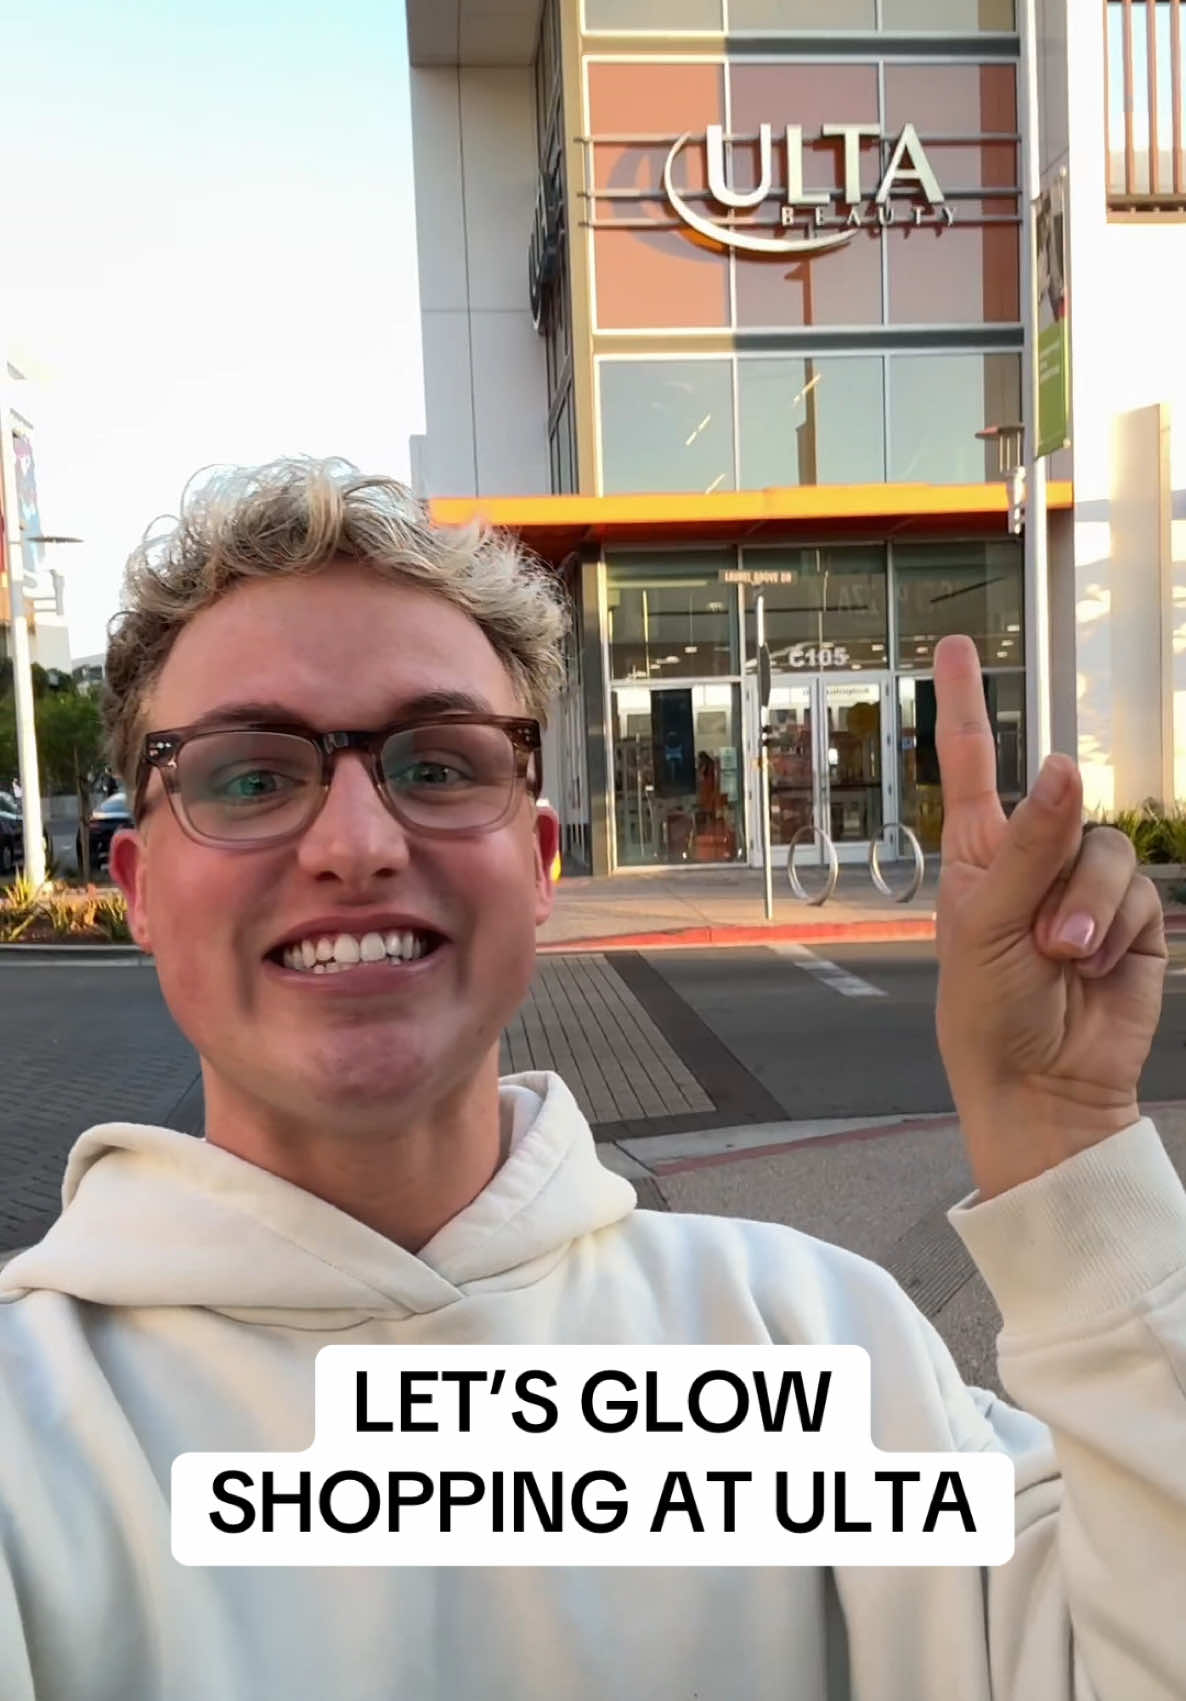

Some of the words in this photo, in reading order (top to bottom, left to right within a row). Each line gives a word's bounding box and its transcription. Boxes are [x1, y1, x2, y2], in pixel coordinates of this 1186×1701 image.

[706, 122, 944, 207] ULTA
[782, 205, 955, 226] BEAUTY
[789, 646, 850, 667] C105
